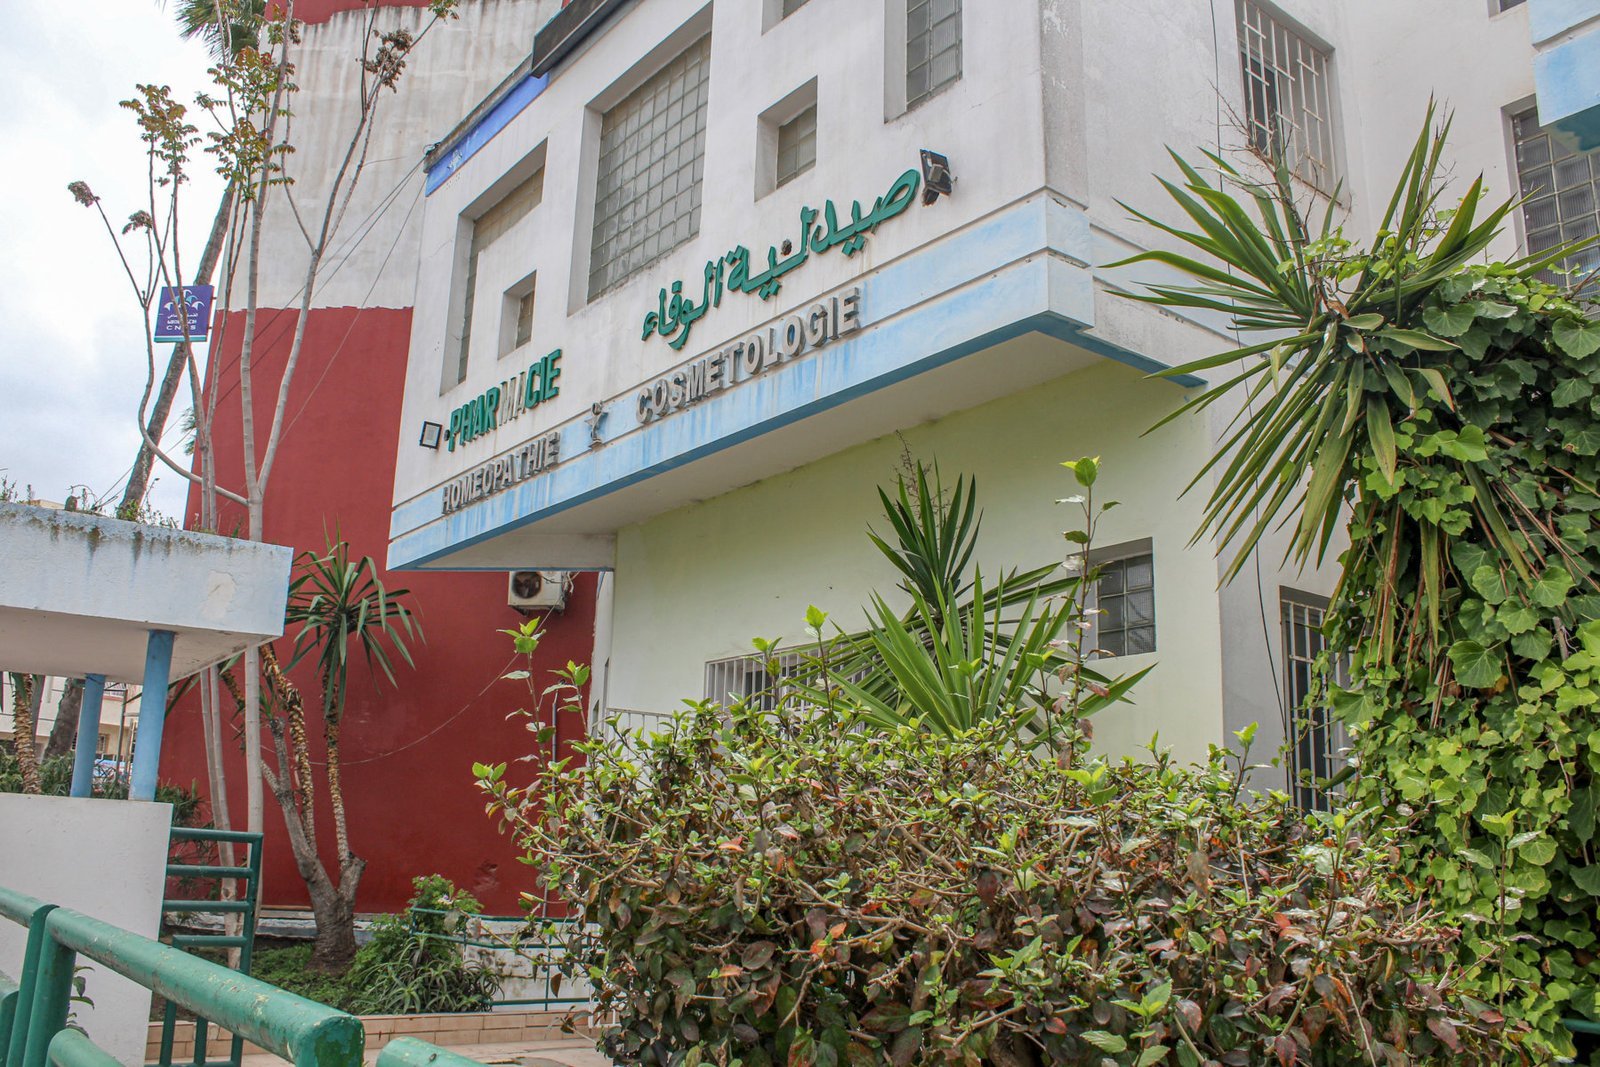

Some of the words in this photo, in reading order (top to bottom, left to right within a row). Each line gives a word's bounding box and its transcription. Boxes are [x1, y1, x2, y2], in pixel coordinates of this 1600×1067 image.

[726, 168, 921, 302] صيدلية
[641, 256, 725, 351] الوفاء
[442, 431, 561, 515] HOMEOPATHIE
[635, 286, 862, 425] COSMETOLOGIE
[448, 348, 563, 453] PHARMACIE
